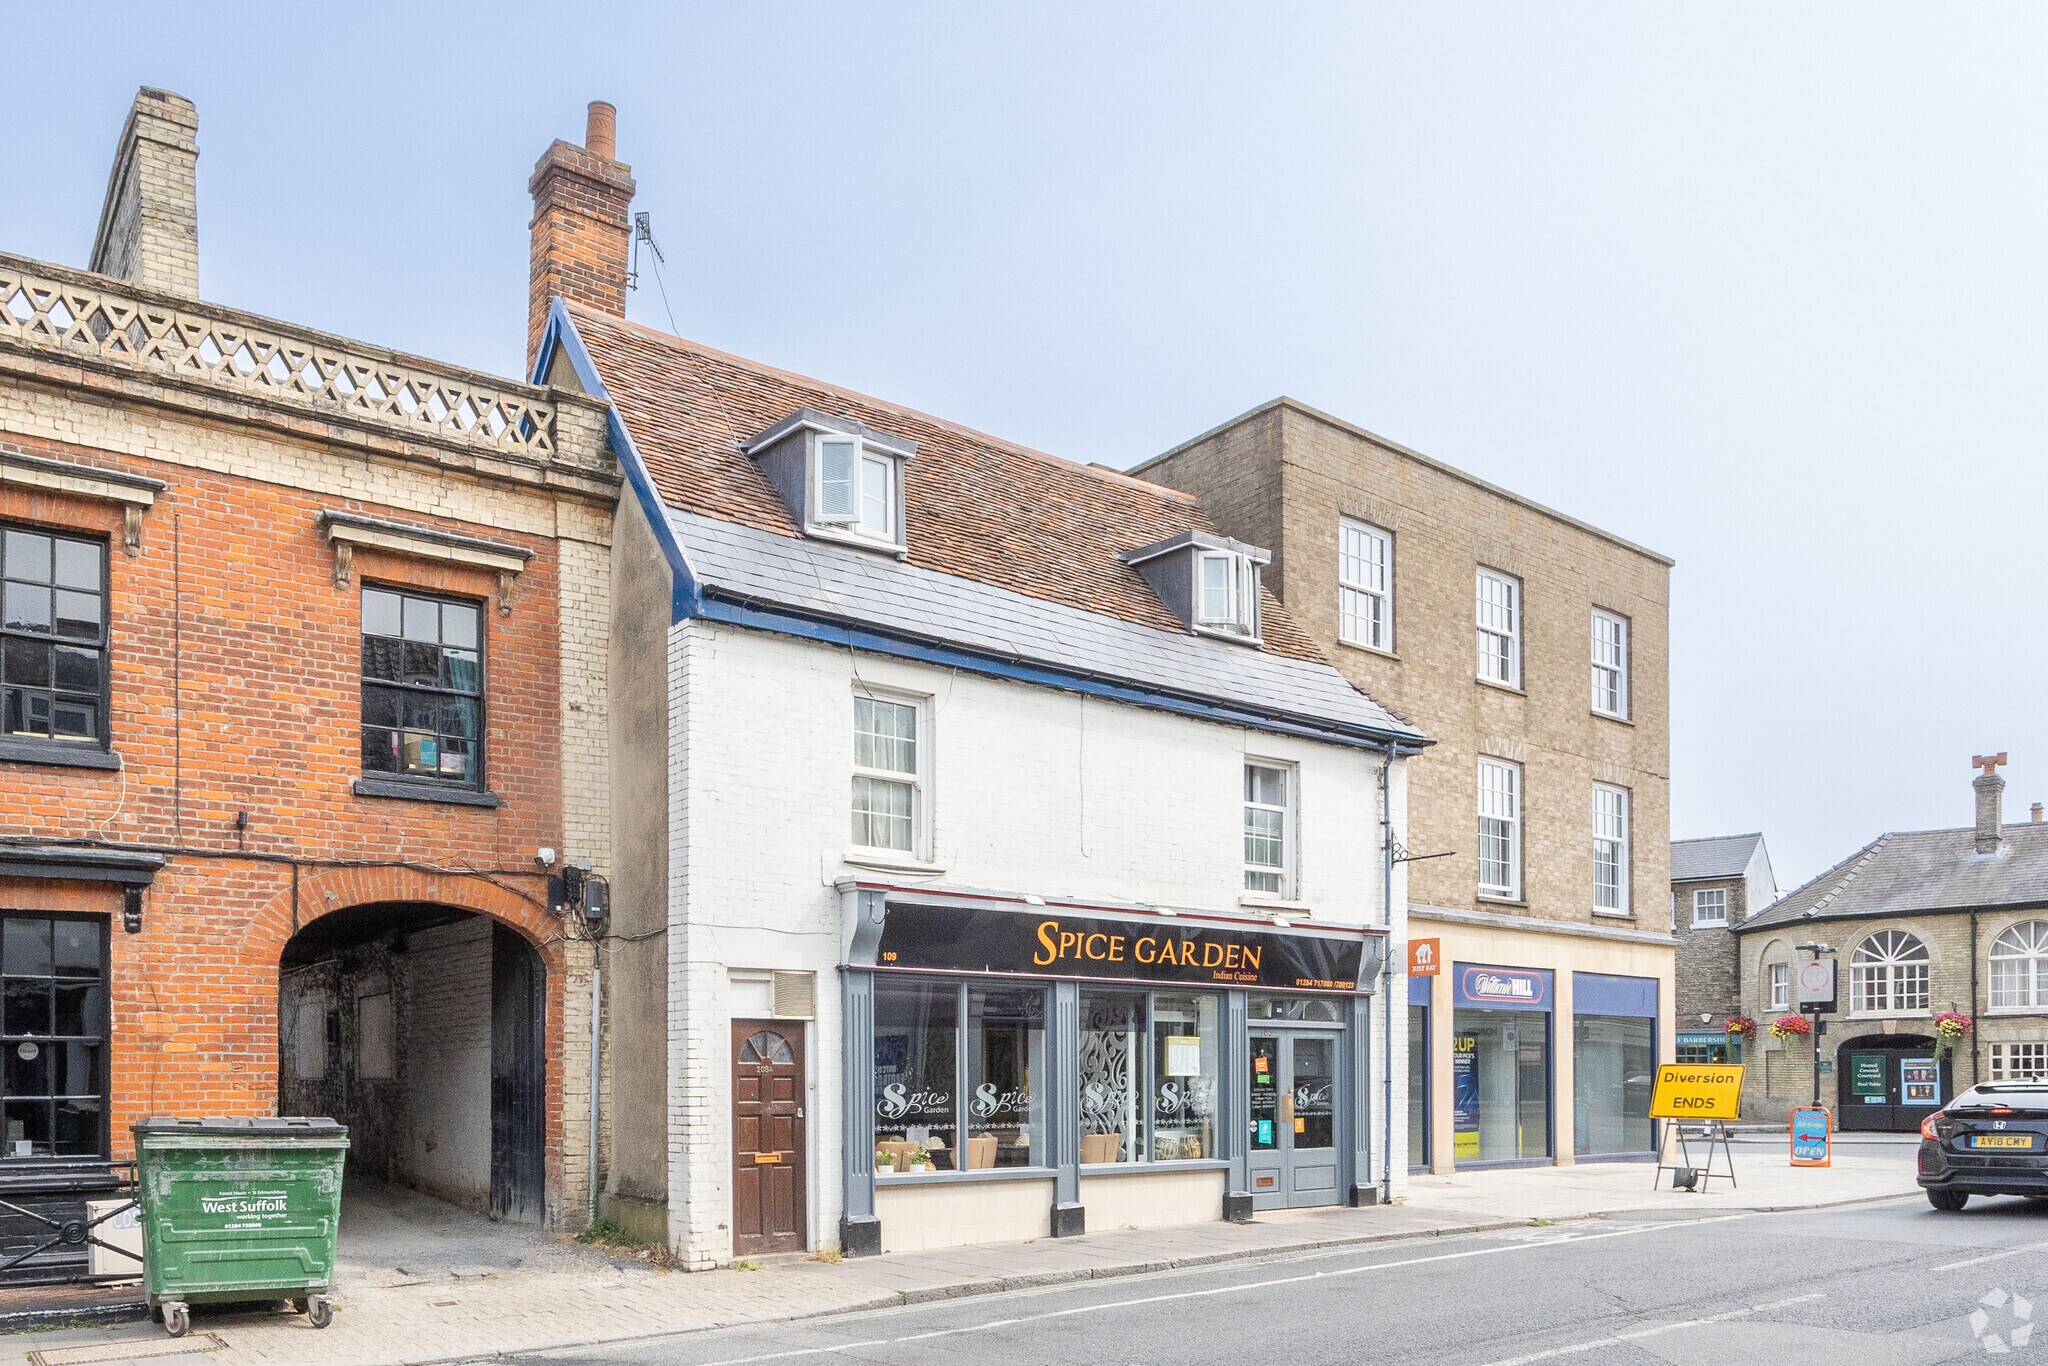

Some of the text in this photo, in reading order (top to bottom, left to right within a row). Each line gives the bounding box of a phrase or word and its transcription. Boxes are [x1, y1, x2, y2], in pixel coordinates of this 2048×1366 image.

[1033, 921, 1263, 970] SPICE GARDEN
[883, 951, 897, 961] 109
[1213, 970, 1258, 981] Indian Cuisine
[1475, 973, 1533, 996] William HILL
[1664, 1072, 1734, 1084] Diversion
[877, 1083, 949, 1119] Spice
[970, 1083, 1036, 1118] Spice
[1673, 1097, 1716, 1109] ENDS
[1980, 1137, 2003, 1146] AV18
[1794, 1146, 1825, 1156] OPEN
[202, 1200, 287, 1213] West Suffolk
